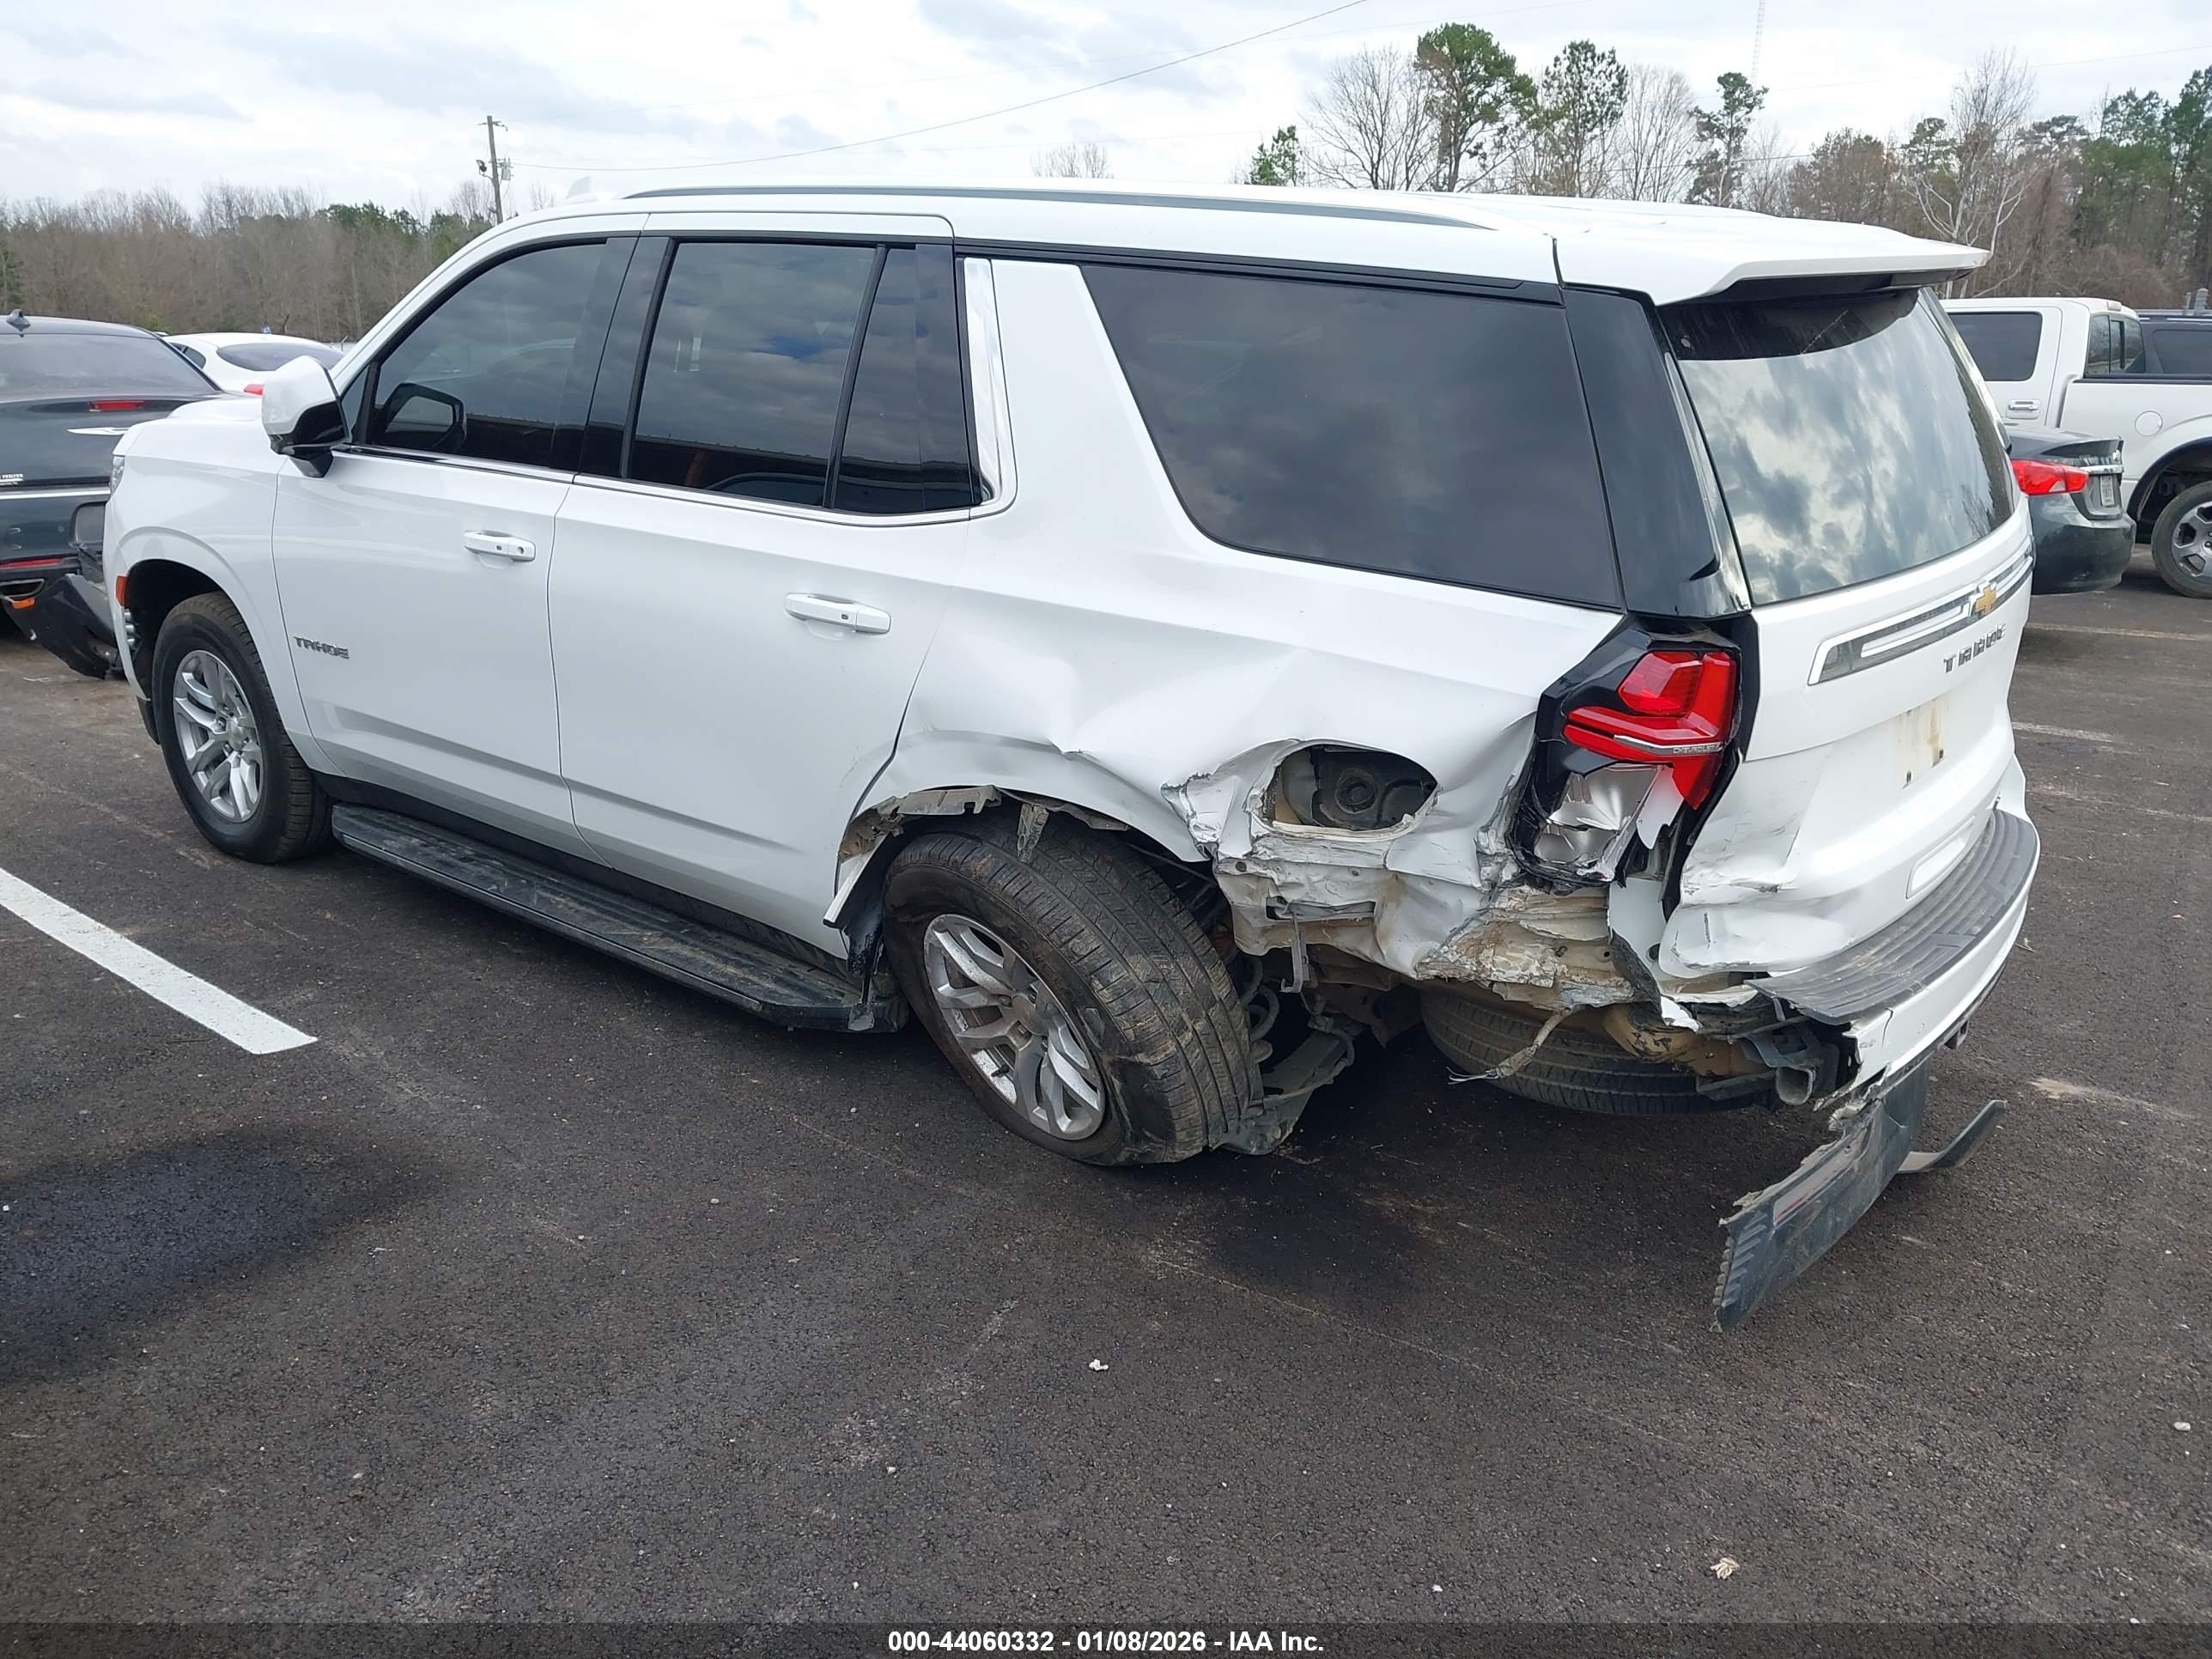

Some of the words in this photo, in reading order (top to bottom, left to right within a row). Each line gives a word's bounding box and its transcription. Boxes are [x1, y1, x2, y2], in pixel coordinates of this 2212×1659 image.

[293, 636, 349, 659] TAHOE
[1943, 623, 2006, 673] TAHOE
[1673, 744, 1717, 754] CHEVROLET
